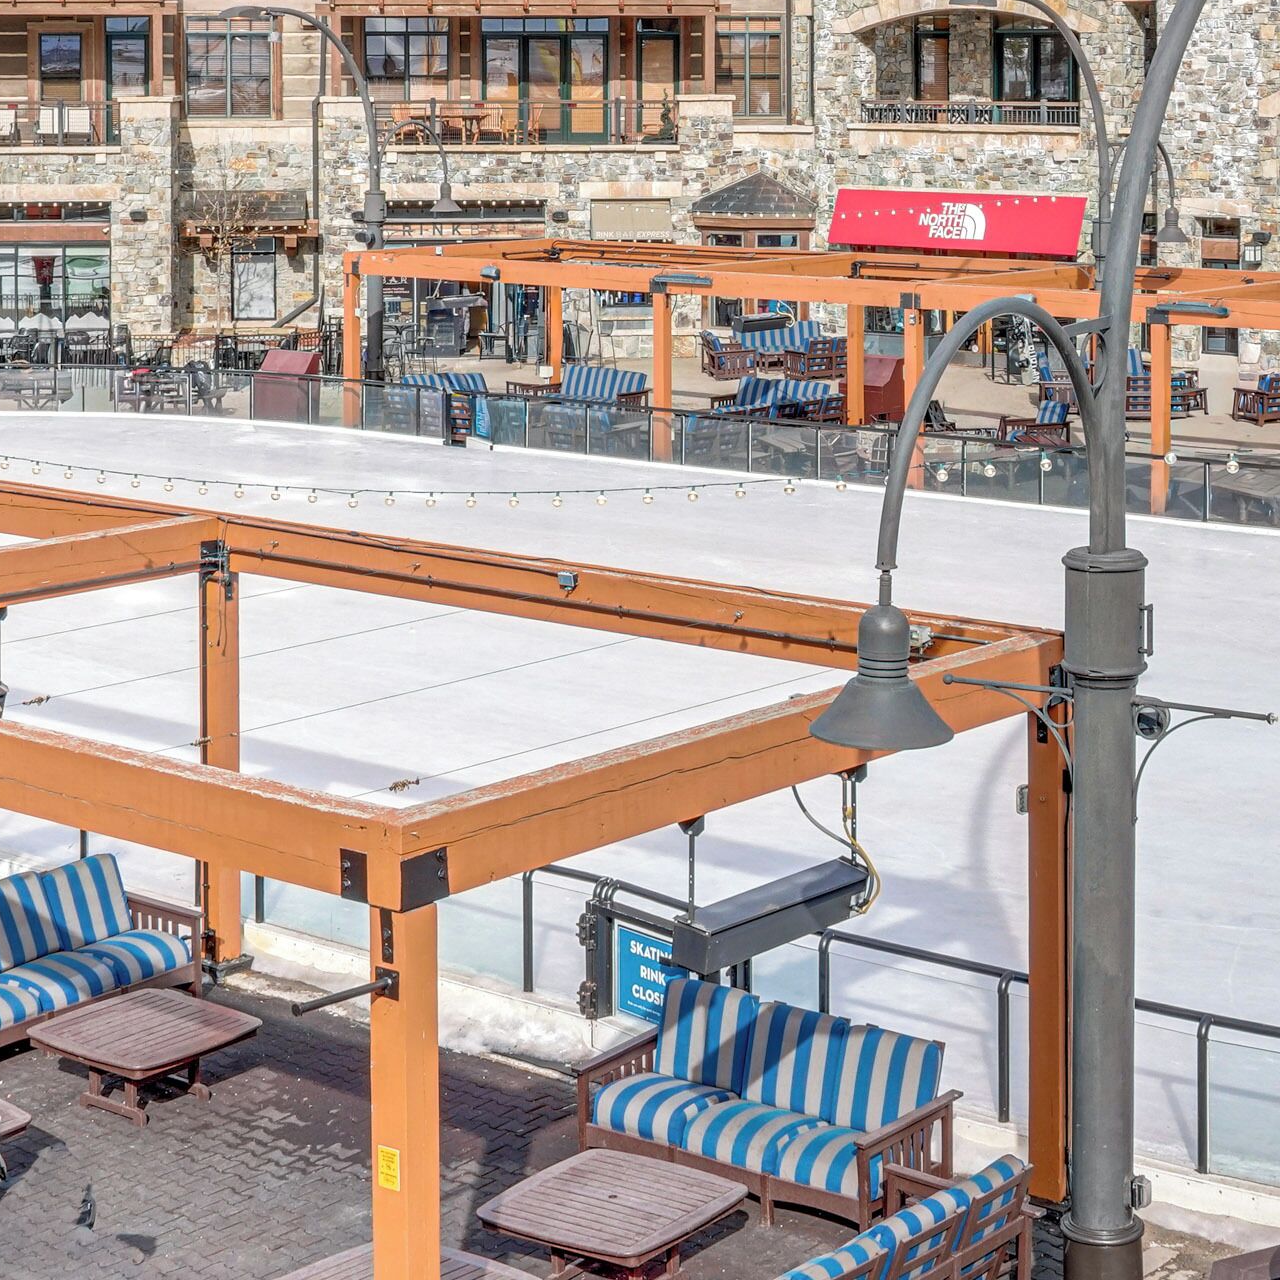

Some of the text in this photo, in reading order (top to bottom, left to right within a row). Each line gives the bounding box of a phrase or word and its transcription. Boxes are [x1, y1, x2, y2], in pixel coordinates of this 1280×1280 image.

[941, 202, 966, 215] THE
[918, 213, 963, 227] NORTH
[402, 224, 463, 236] RINK
[928, 226, 961, 239] FACE
[640, 965, 666, 986] RINK
